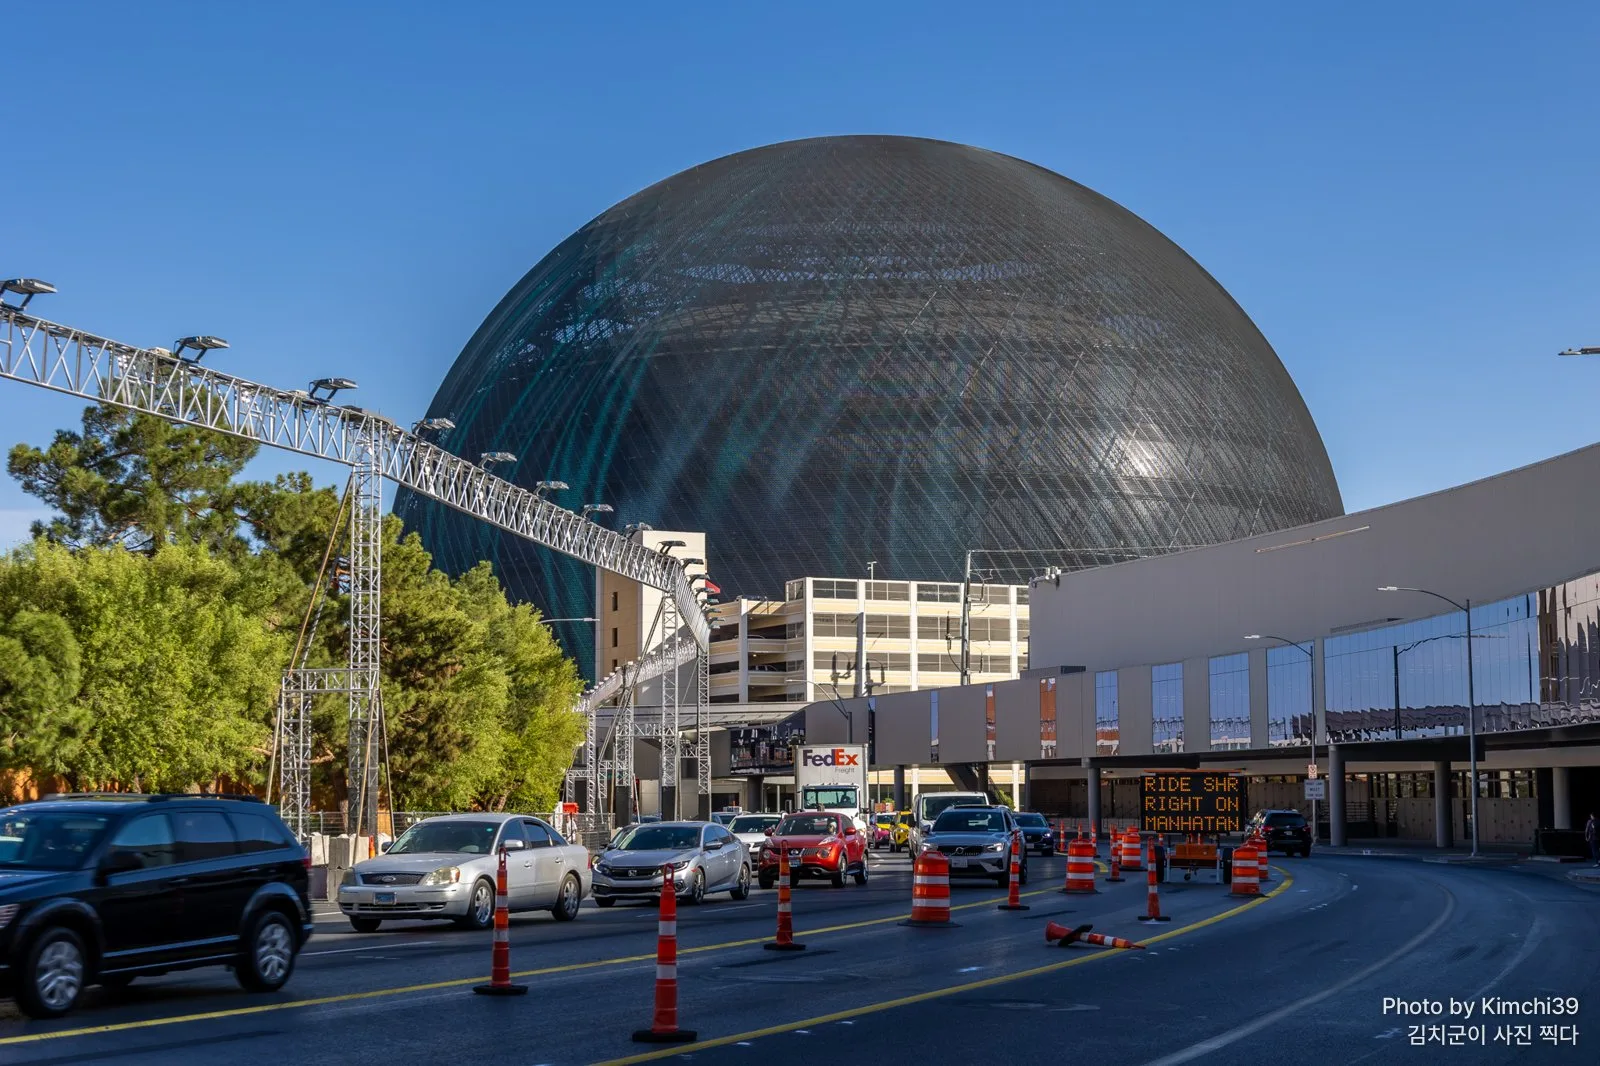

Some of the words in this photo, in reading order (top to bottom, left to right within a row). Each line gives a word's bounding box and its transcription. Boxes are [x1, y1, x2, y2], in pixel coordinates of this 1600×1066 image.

[802, 748, 859, 767] FedEx
[1145, 777, 1191, 792] RIDE
[1203, 777, 1238, 792] SHR
[1145, 796, 1203, 811] RIGHT
[1216, 796, 1239, 811] ON
[1145, 816, 1239, 831] MANHATAN
